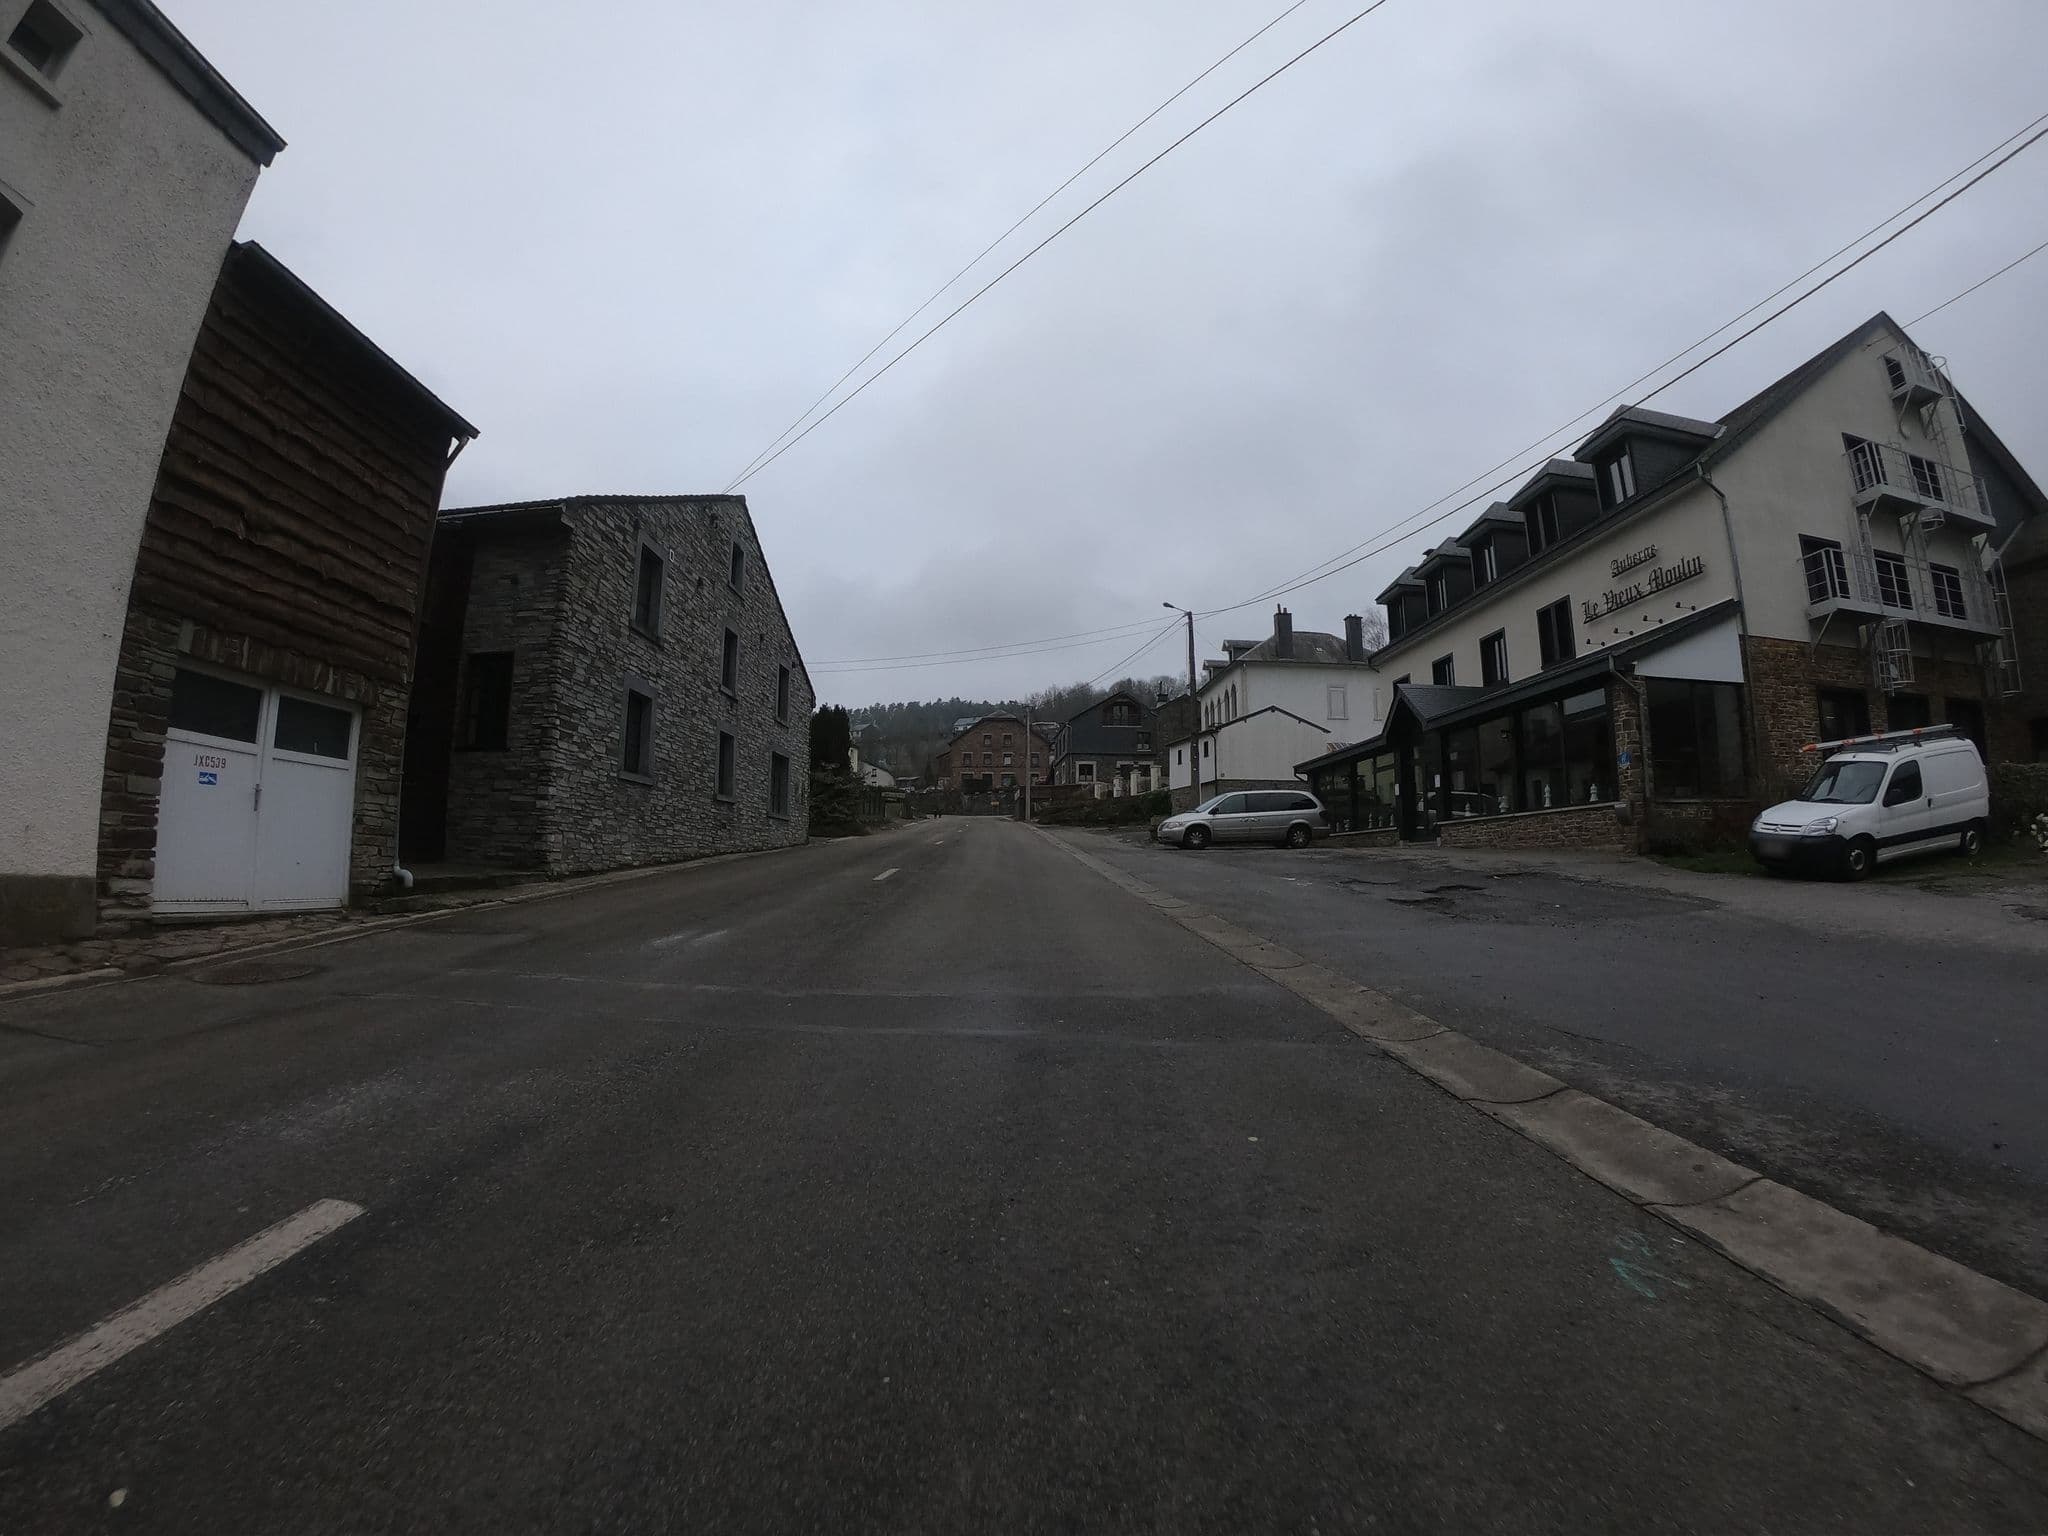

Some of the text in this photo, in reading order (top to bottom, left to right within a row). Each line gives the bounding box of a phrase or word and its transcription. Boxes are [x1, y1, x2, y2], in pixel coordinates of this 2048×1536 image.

[1582, 556, 1705, 621] Le Vieux Moulin
